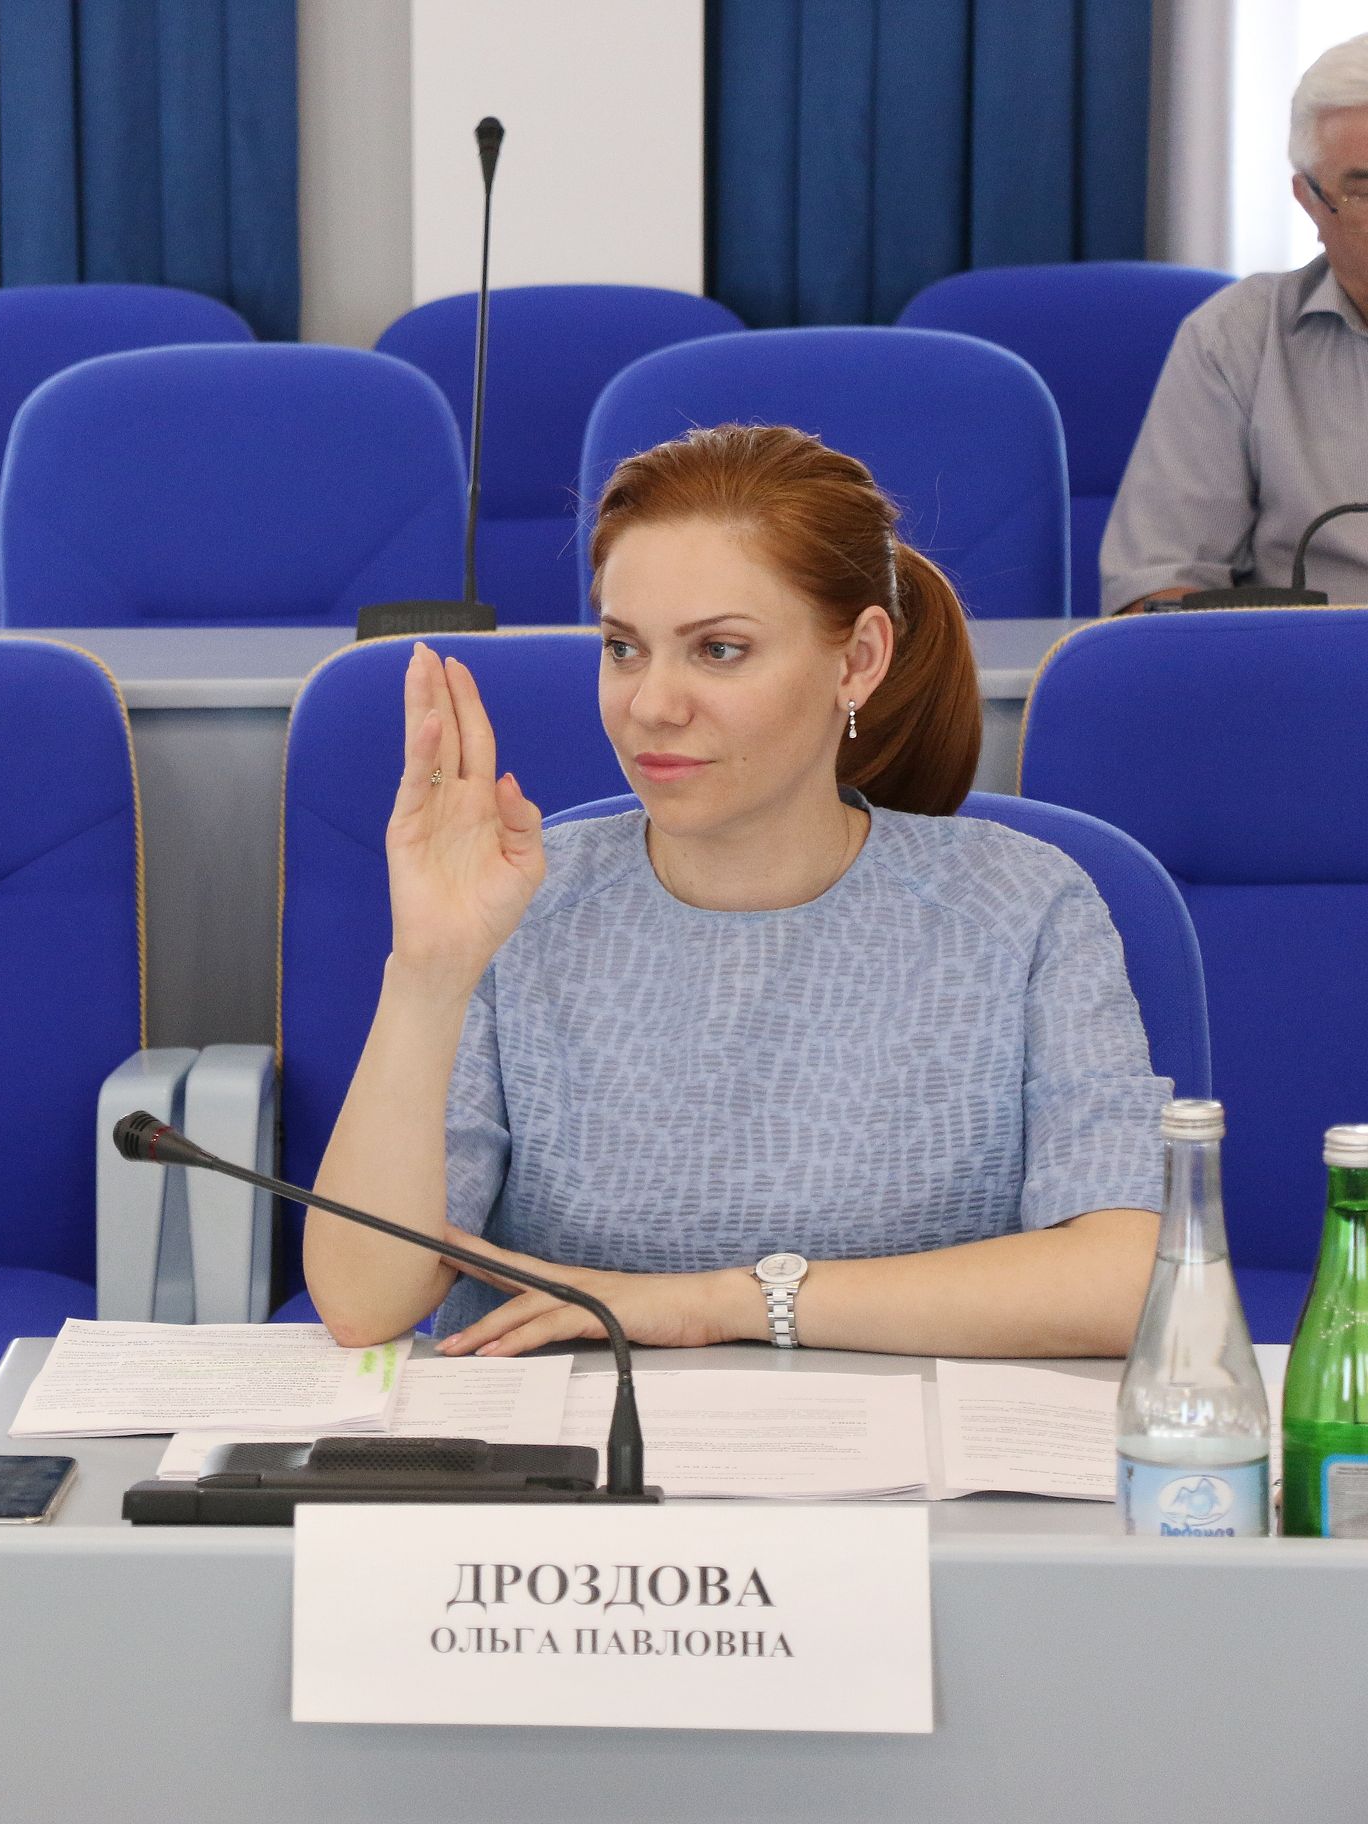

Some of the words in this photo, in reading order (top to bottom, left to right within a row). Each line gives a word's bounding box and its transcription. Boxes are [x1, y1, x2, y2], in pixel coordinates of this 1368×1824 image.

[446, 1562, 776, 1613] ДРОЗДОВА
[430, 1626, 560, 1655] ОЛЬГА
[574, 1628, 795, 1658] ПАВЛОВНА
